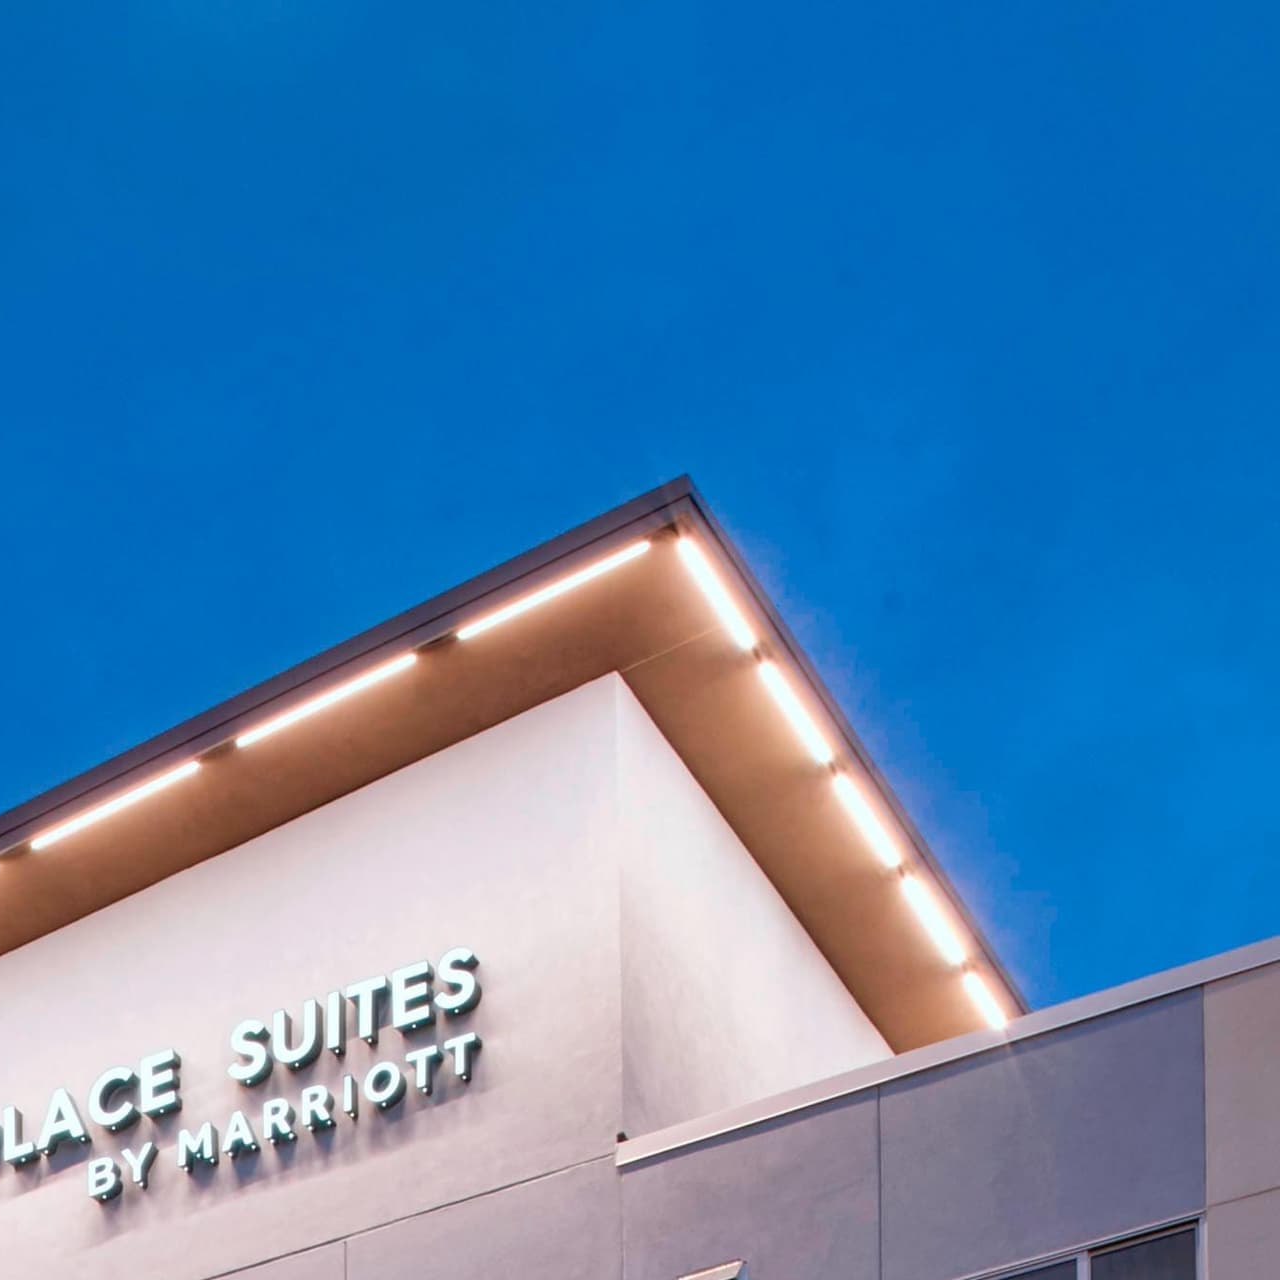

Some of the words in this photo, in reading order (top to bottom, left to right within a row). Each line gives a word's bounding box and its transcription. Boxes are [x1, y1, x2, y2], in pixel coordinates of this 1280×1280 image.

[226, 947, 480, 1084] SUITES
[87, 1142, 158, 1201] BY
[177, 1031, 481, 1170] MARRIOTT
